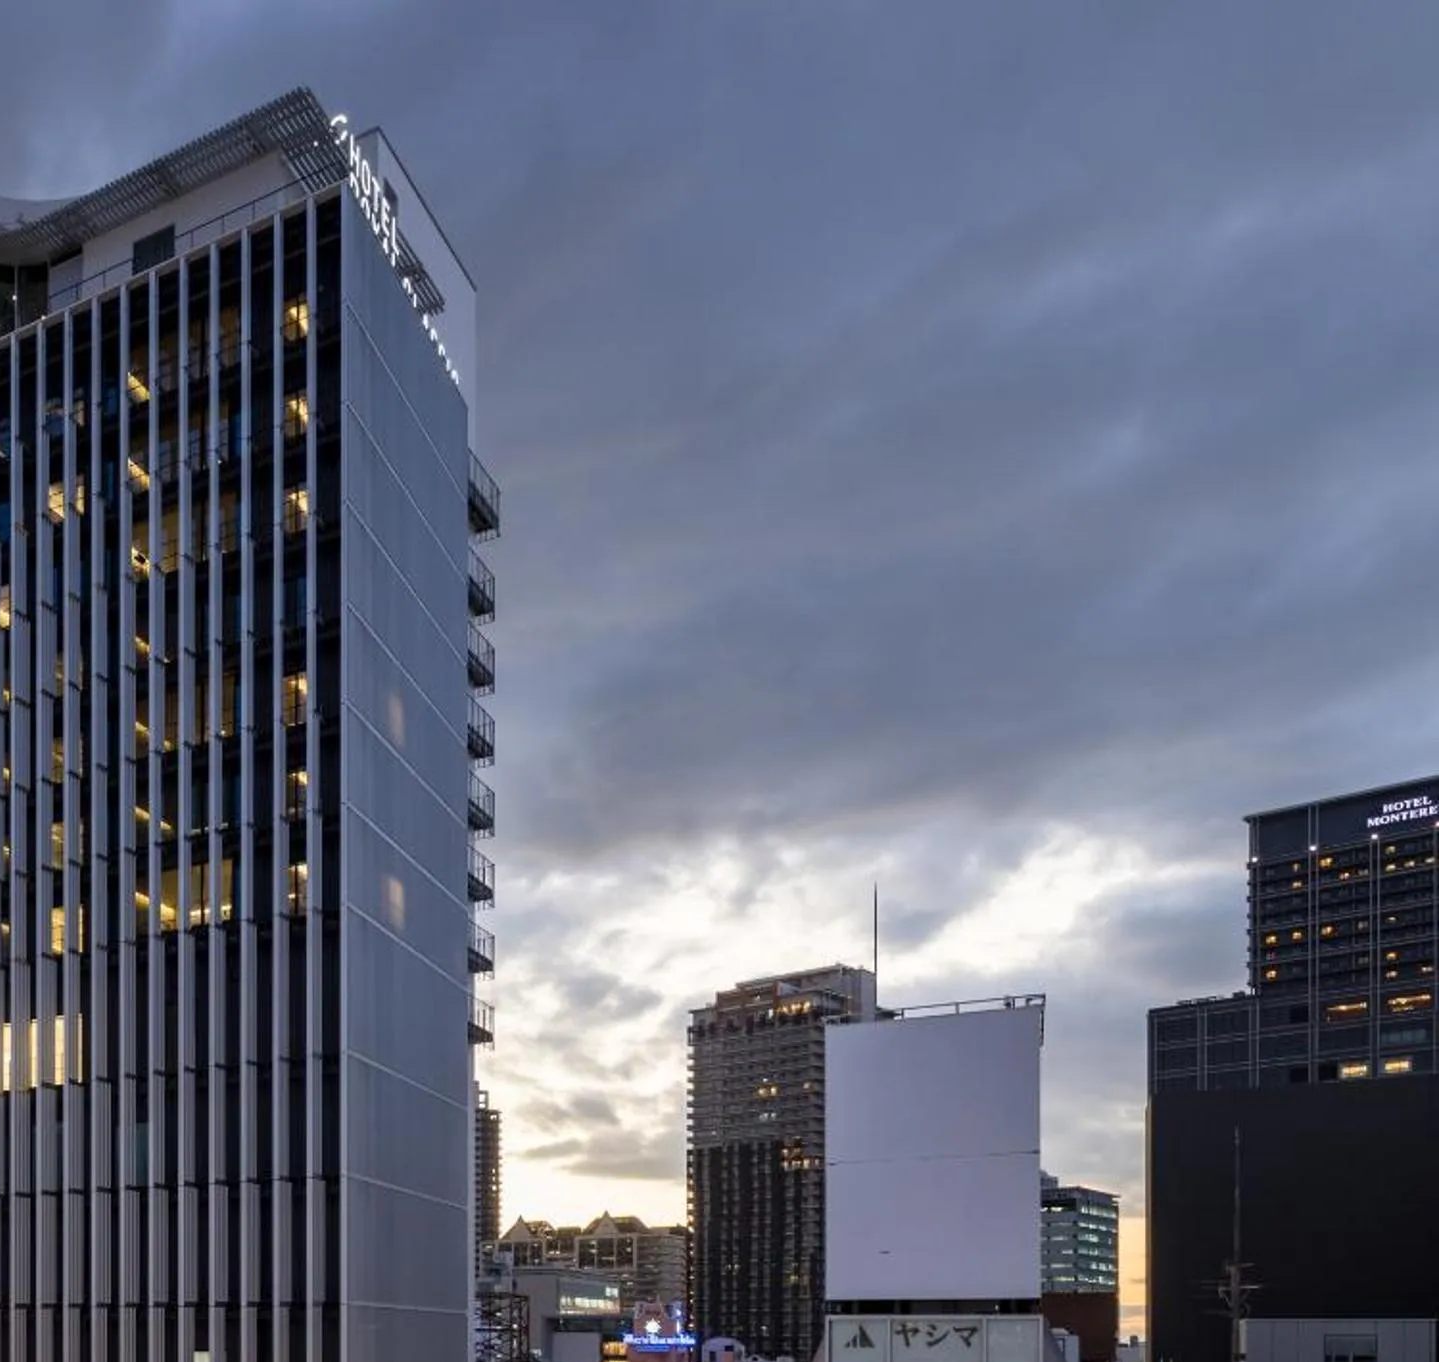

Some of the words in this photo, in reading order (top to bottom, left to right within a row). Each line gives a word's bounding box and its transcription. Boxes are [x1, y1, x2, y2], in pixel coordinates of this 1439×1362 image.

[349, 134, 399, 256] HOTEL
[1382, 796, 1432, 814] HOTEL
[1367, 806, 1439, 828] MONTERE
[895, 1324, 979, 1348] ヤシマ
